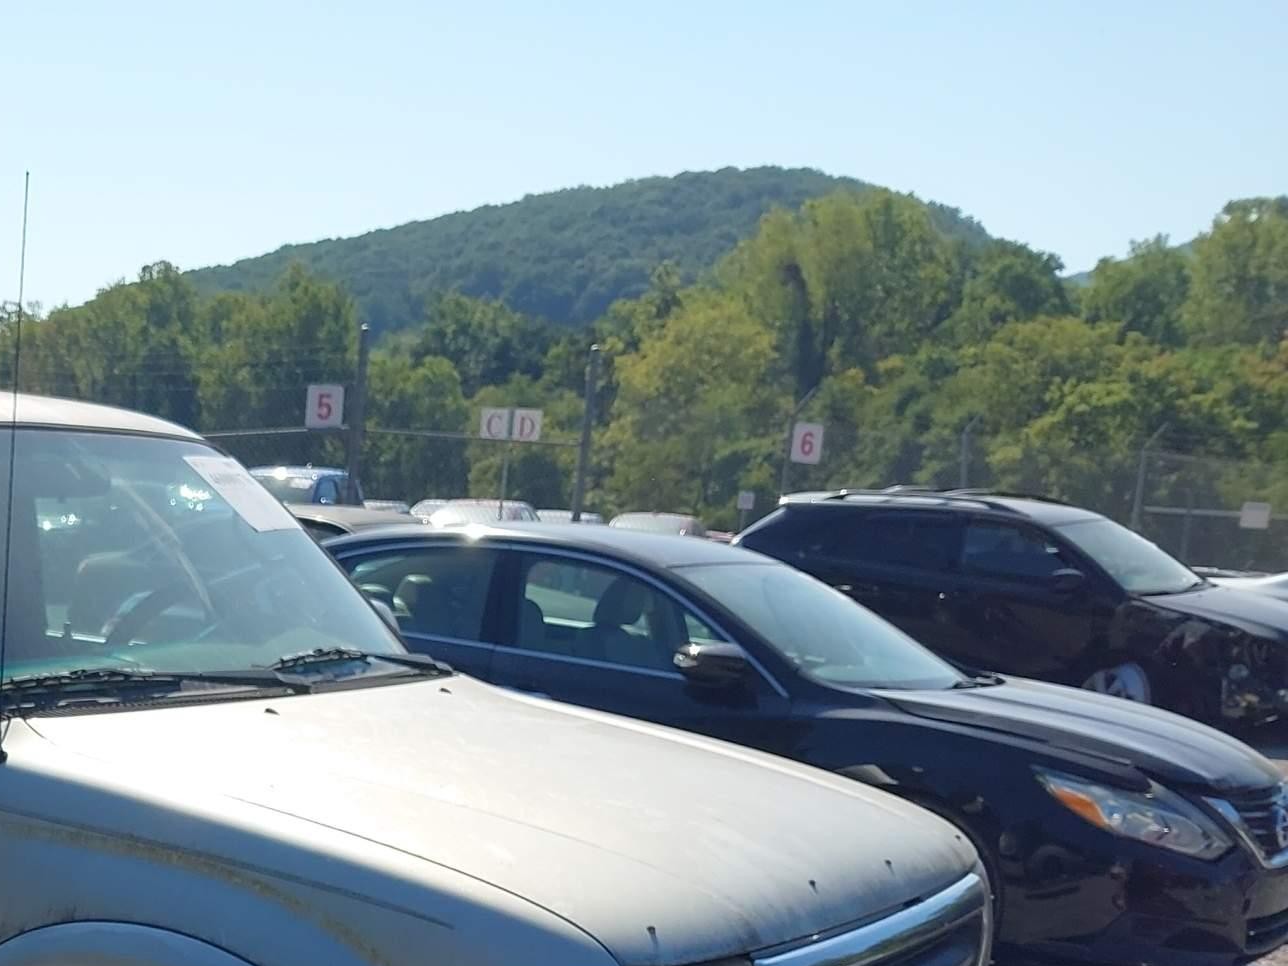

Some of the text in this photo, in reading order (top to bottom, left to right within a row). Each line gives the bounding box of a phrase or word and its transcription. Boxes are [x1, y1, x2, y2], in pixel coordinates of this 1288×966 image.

[316, 392, 333, 421] 5
[485, 414, 536, 439] C D
[799, 431, 815, 457] 6
